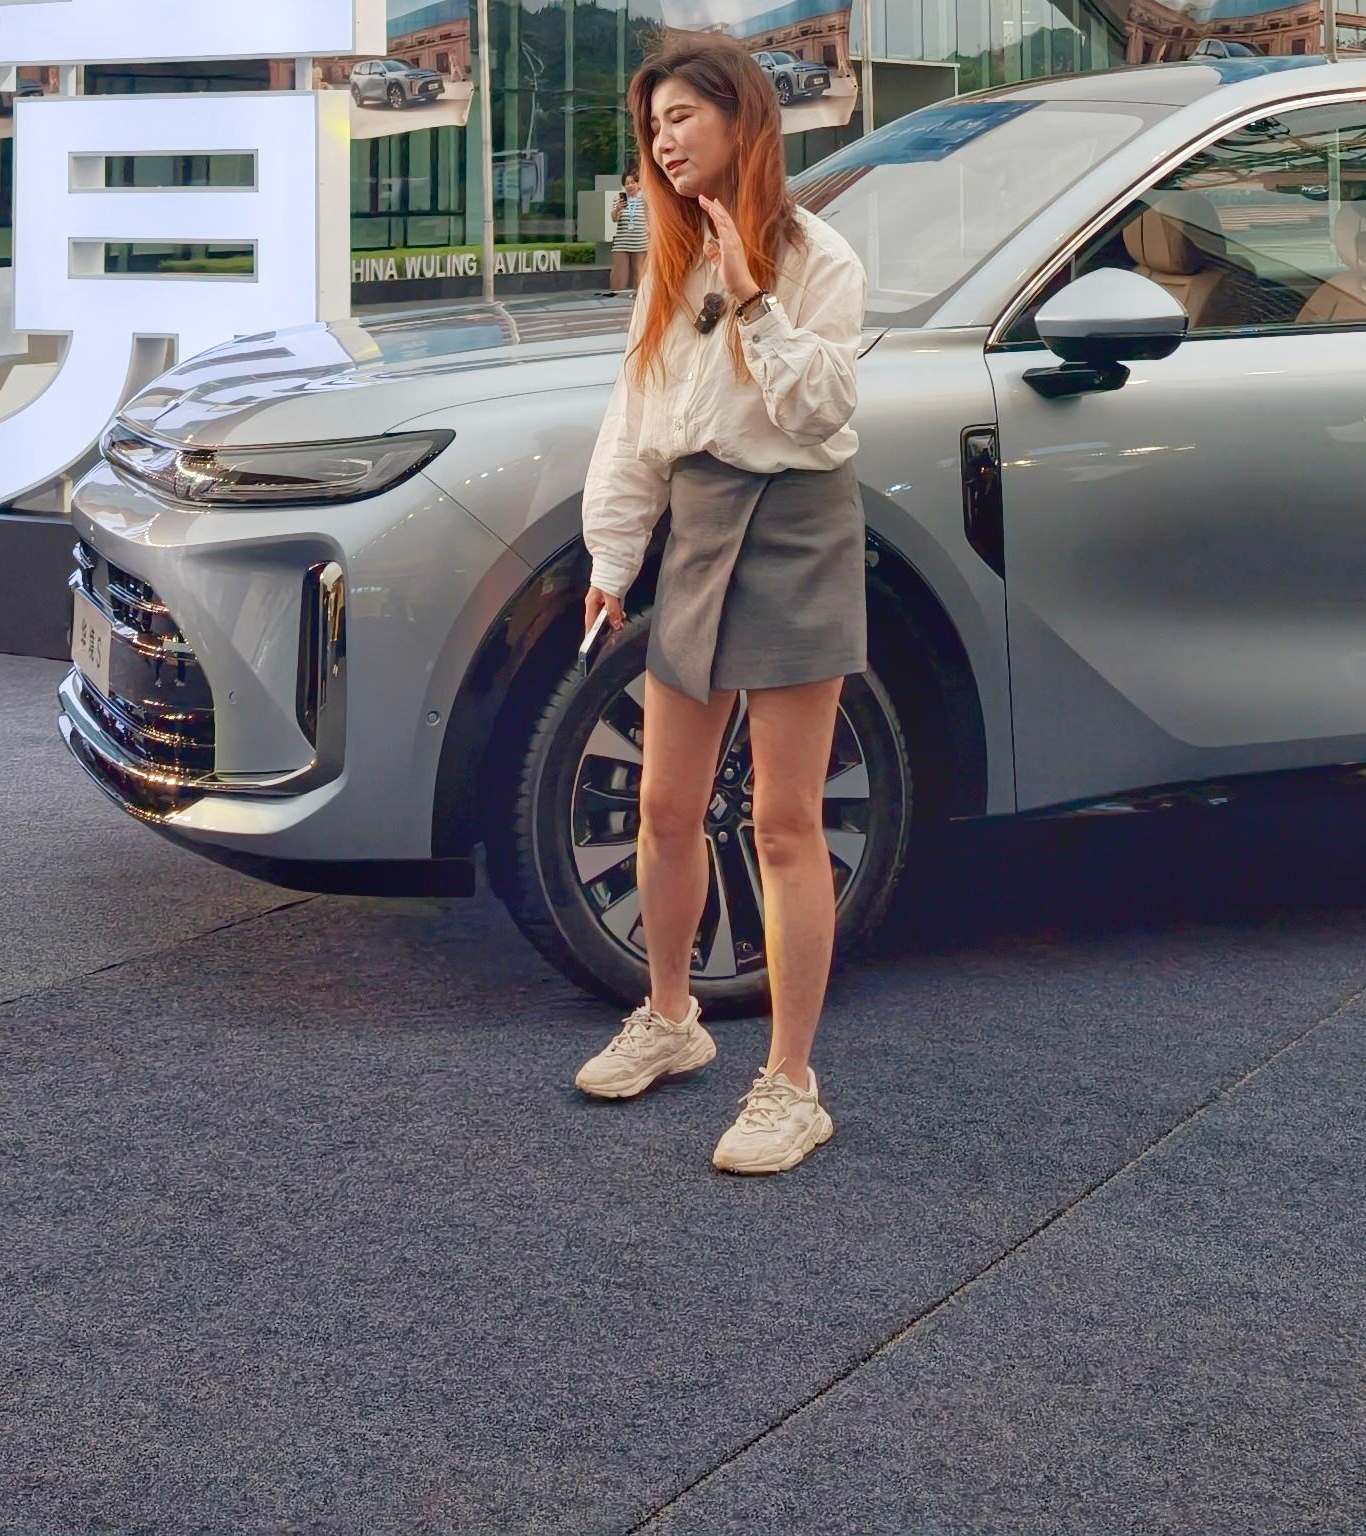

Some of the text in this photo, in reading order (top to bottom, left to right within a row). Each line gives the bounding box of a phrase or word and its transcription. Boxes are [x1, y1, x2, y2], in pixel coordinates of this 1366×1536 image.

[351, 249, 562, 282] HINA WULING AVILION
